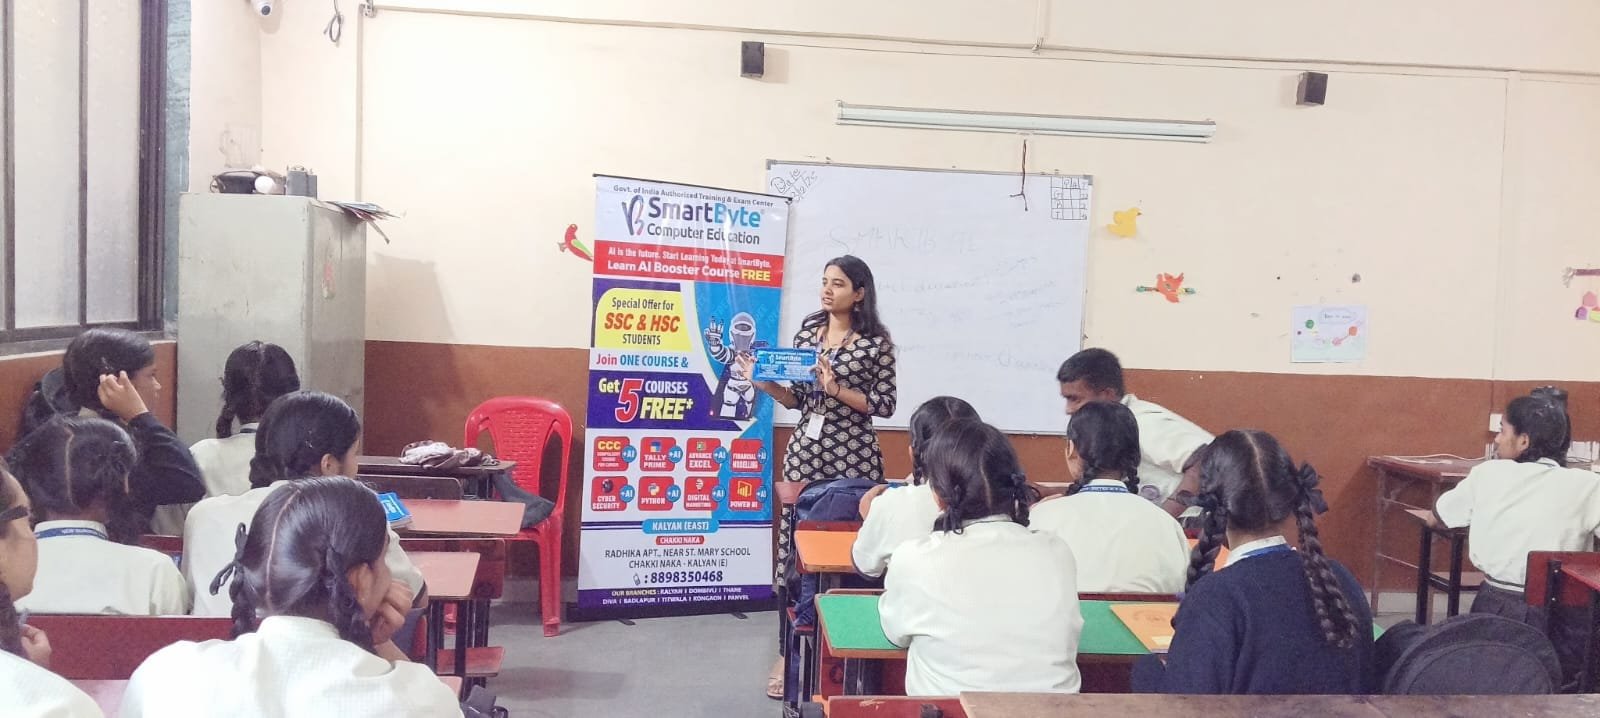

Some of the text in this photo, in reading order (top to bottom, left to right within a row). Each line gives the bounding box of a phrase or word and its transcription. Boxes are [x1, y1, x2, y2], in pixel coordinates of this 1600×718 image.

[613, 184, 632, 192] Govt.
[700, 193, 725, 203] Training
[648, 196, 760, 228] SmartByte
[647, 223, 704, 240] Computer
[608, 247, 616, 255] AI
[618, 248, 624, 256] is
[626, 248, 636, 257] the
[639, 249, 660, 259] future.
[663, 251, 679, 260] Start
[681, 253, 709, 264] Learning
[608, 260, 771, 281] Learn AI Booster Course FREE
[612, 297, 674, 311] Special Offer for
[604, 312, 680, 333] SSC & HSC
[623, 334, 661, 345] STUDENTS
[596, 354, 688, 368] Join ONE COURSE &
[599, 378, 688, 423] Get 5 COURSES
[598, 441, 621, 450] CCC
[689, 460, 712, 468] EXCEL
[652, 522, 709, 530] KALYAN (EAST)
[605, 549, 641, 558] RADHIKA
[663, 548, 684, 557] NEAR
[685, 548, 695, 557] ST.
[698, 548, 719, 556] MARY
[721, 548, 750, 556] SCHOOL
[629, 560, 658, 568] CHAKKI
[687, 559, 717, 567] KALYAN
[719, 559, 728, 567] (E)
